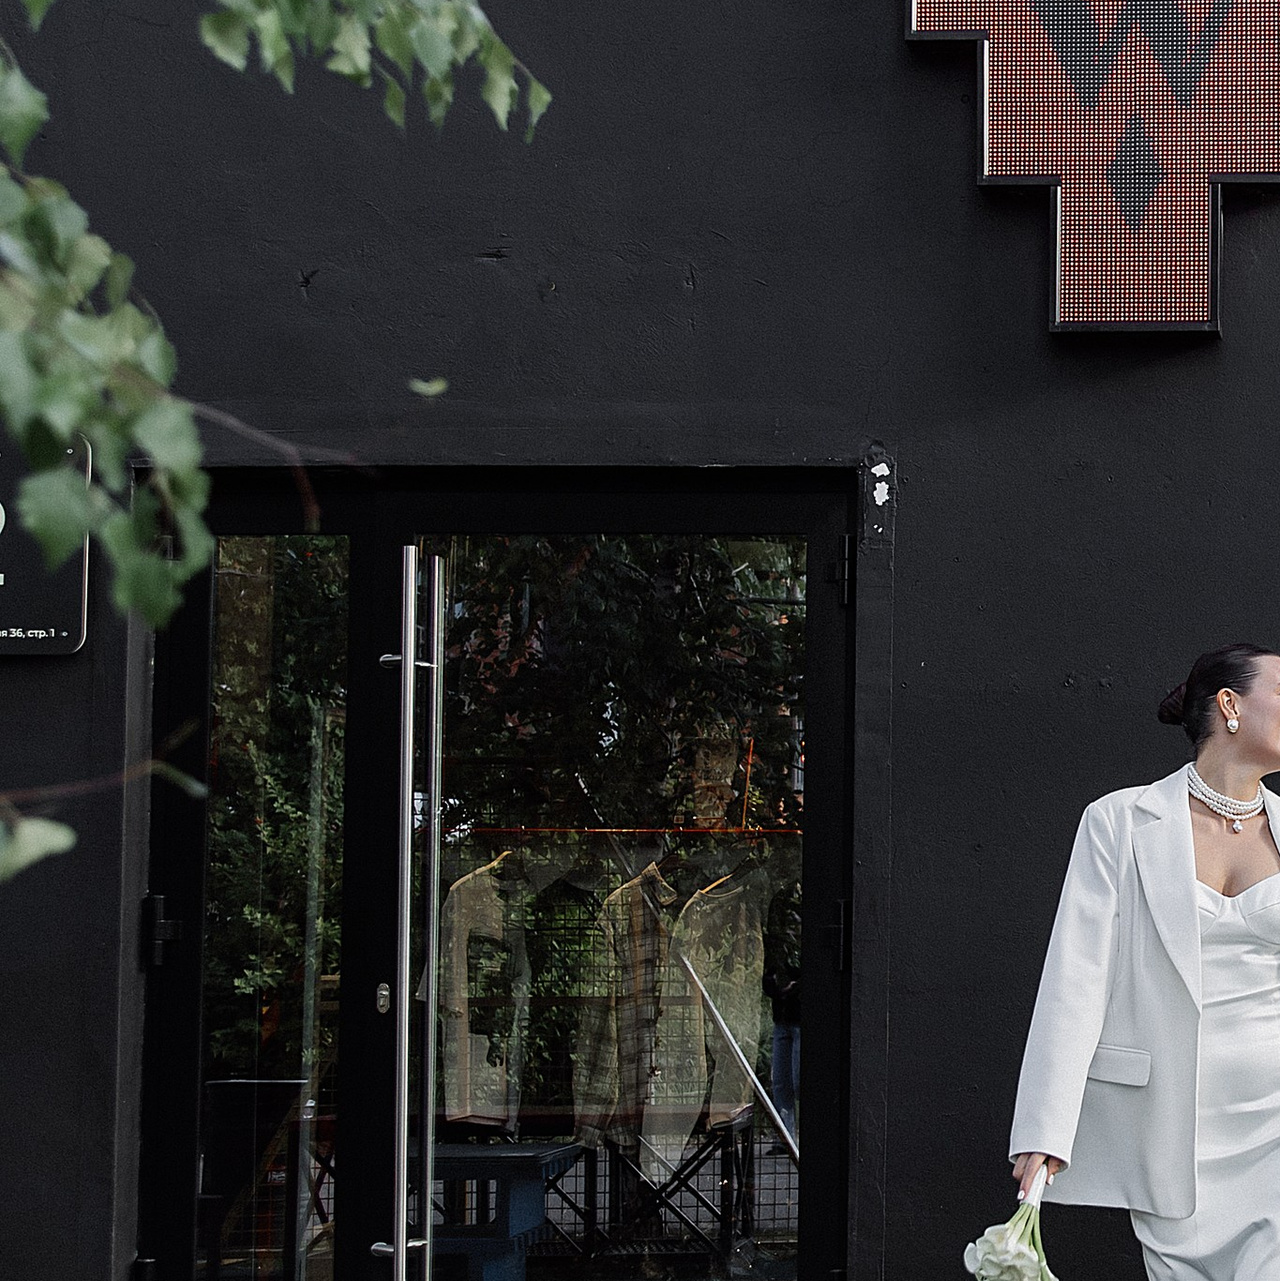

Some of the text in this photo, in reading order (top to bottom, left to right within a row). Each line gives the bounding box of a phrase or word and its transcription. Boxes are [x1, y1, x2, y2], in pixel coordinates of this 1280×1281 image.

[9, 628, 26, 639] 36,
[27, 629, 49, 640] стр.
[49, 628, 55, 638] 1
